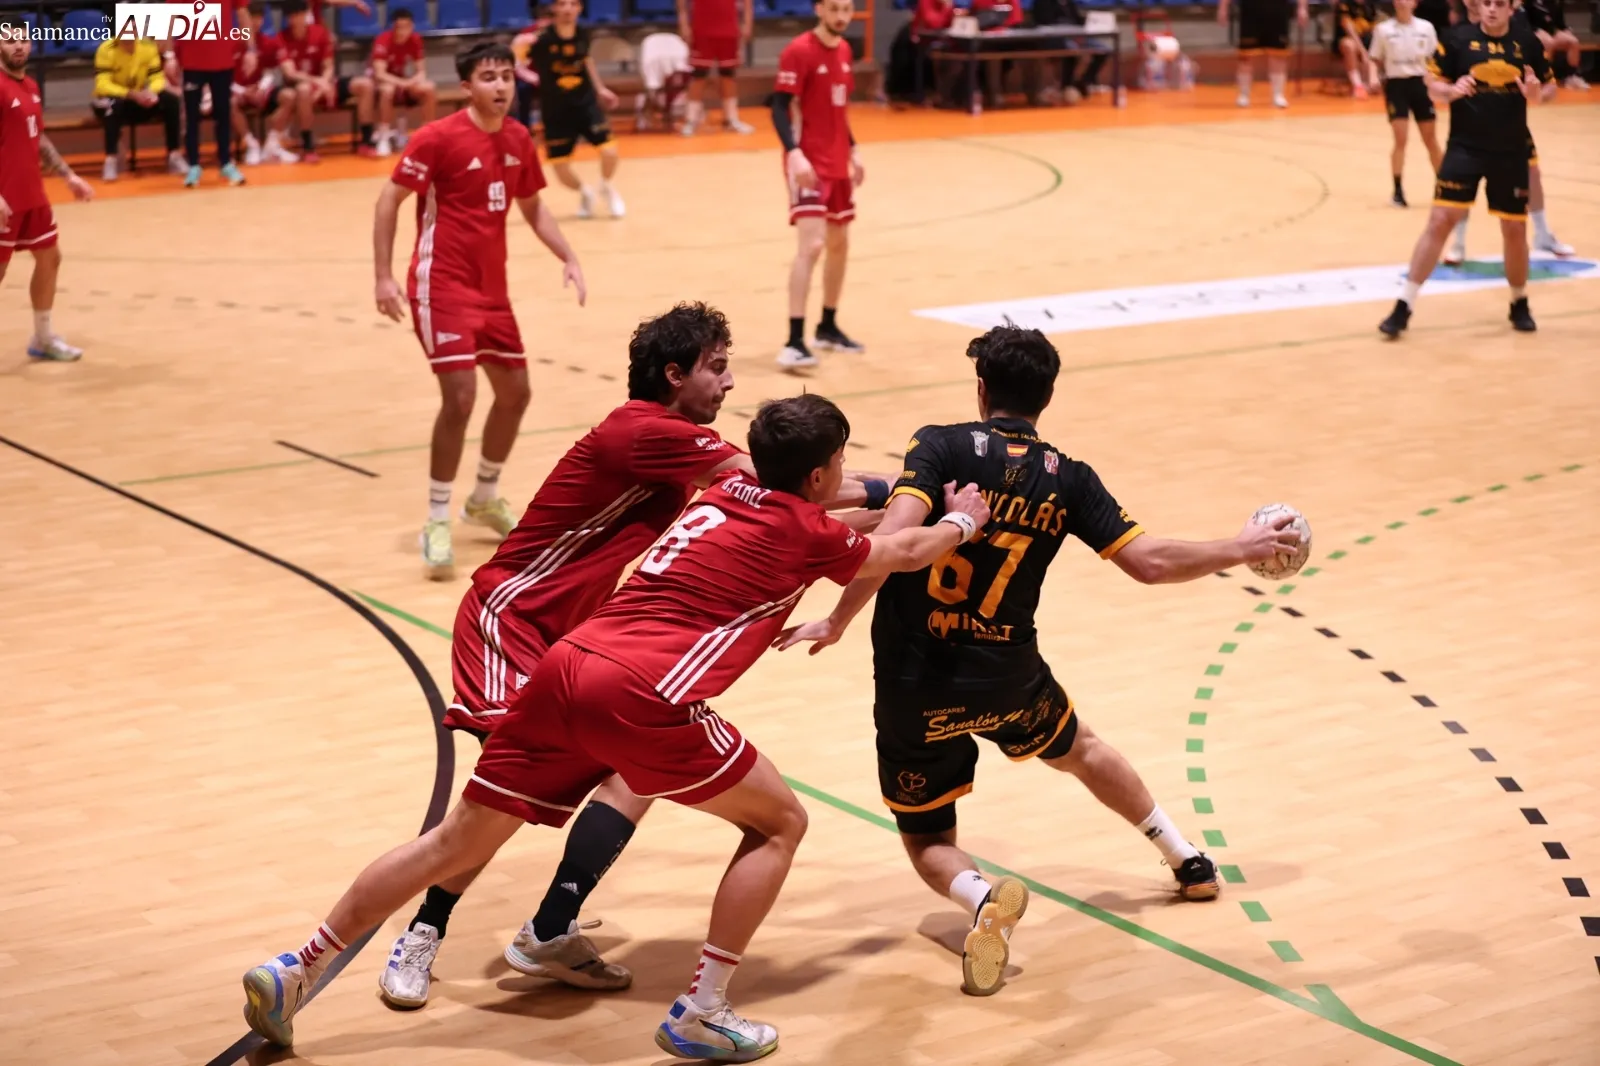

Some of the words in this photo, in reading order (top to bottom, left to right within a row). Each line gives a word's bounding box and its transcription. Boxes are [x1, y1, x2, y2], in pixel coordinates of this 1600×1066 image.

[640, 504, 727, 575] 8
[926, 527, 1034, 619] 67
[922, 706, 966, 717] AUTOCARES
